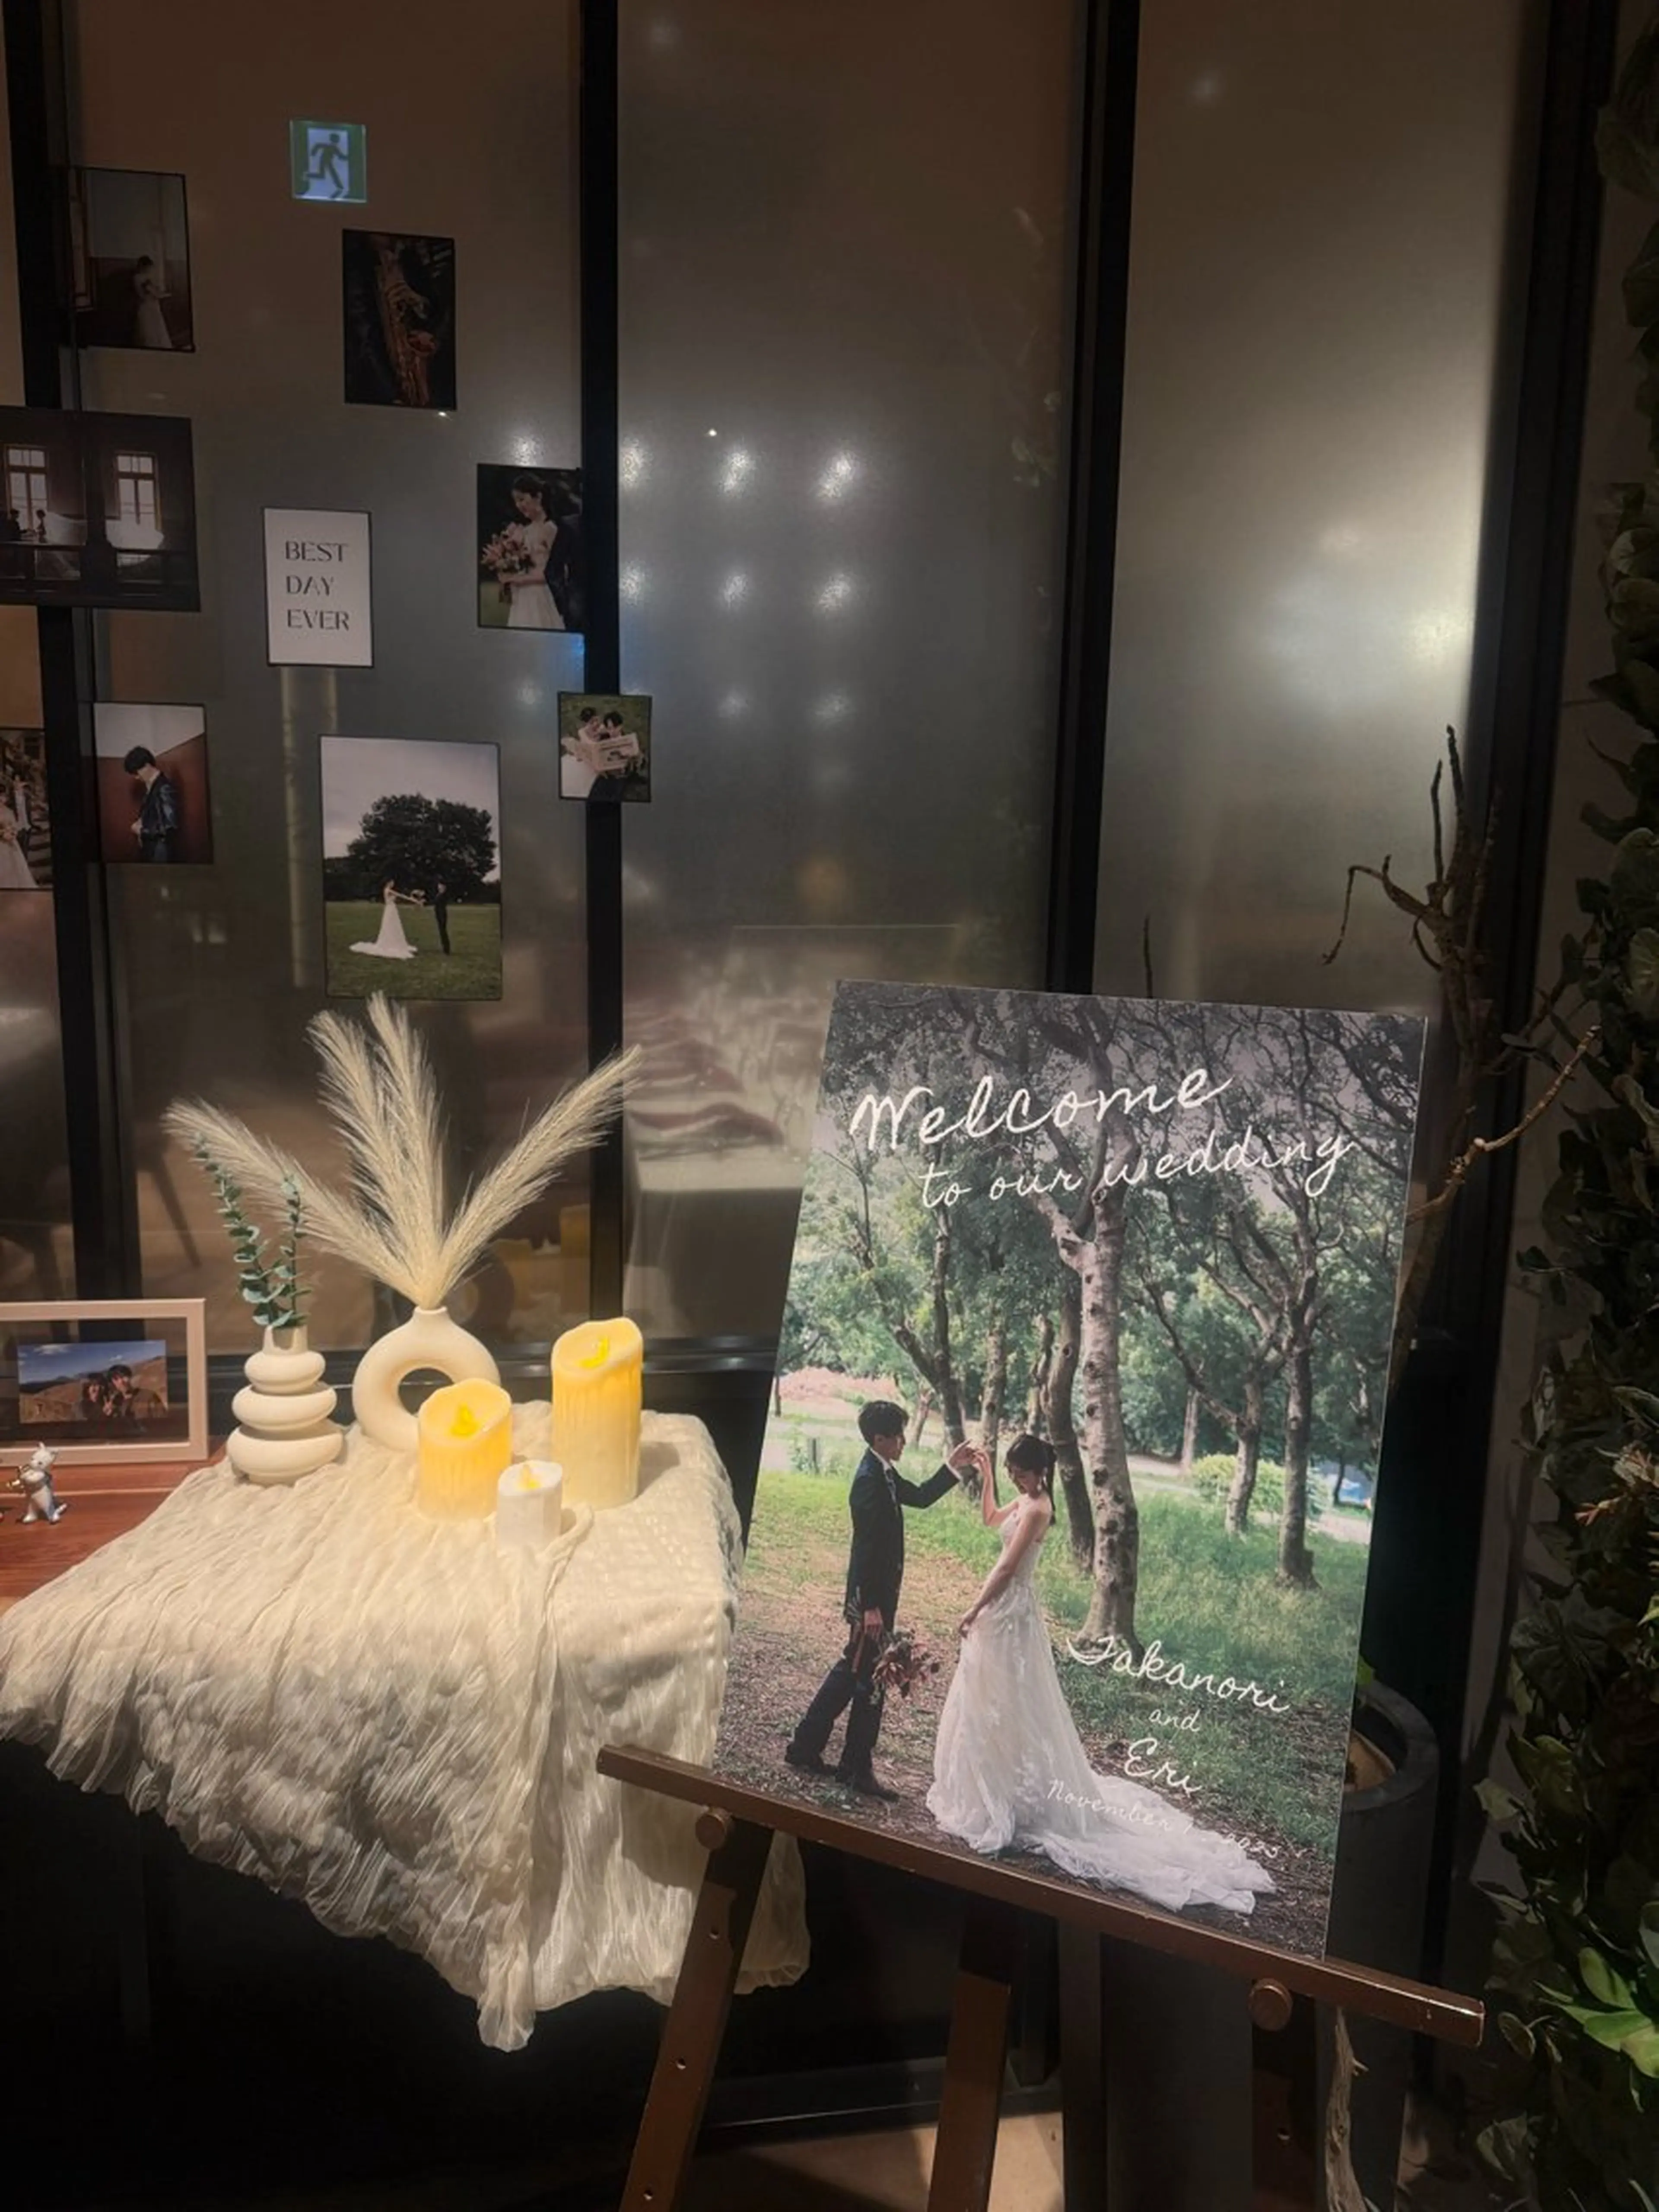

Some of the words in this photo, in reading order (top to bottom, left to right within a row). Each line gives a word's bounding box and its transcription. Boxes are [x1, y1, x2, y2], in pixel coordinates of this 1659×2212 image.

[285, 540, 349, 562] BEST
[286, 575, 334, 597] DAY
[287, 609, 350, 632] EVER
[849, 1067, 1234, 1150] Welcome
[918, 1162, 972, 1209] to
[989, 1167, 1083, 1201] our
[1102, 1124, 1356, 1198] wedding
[1066, 1636, 1290, 1712] Takanori
[1149, 1708, 1201, 1732] and
[1124, 1737, 1202, 1797] Eri
